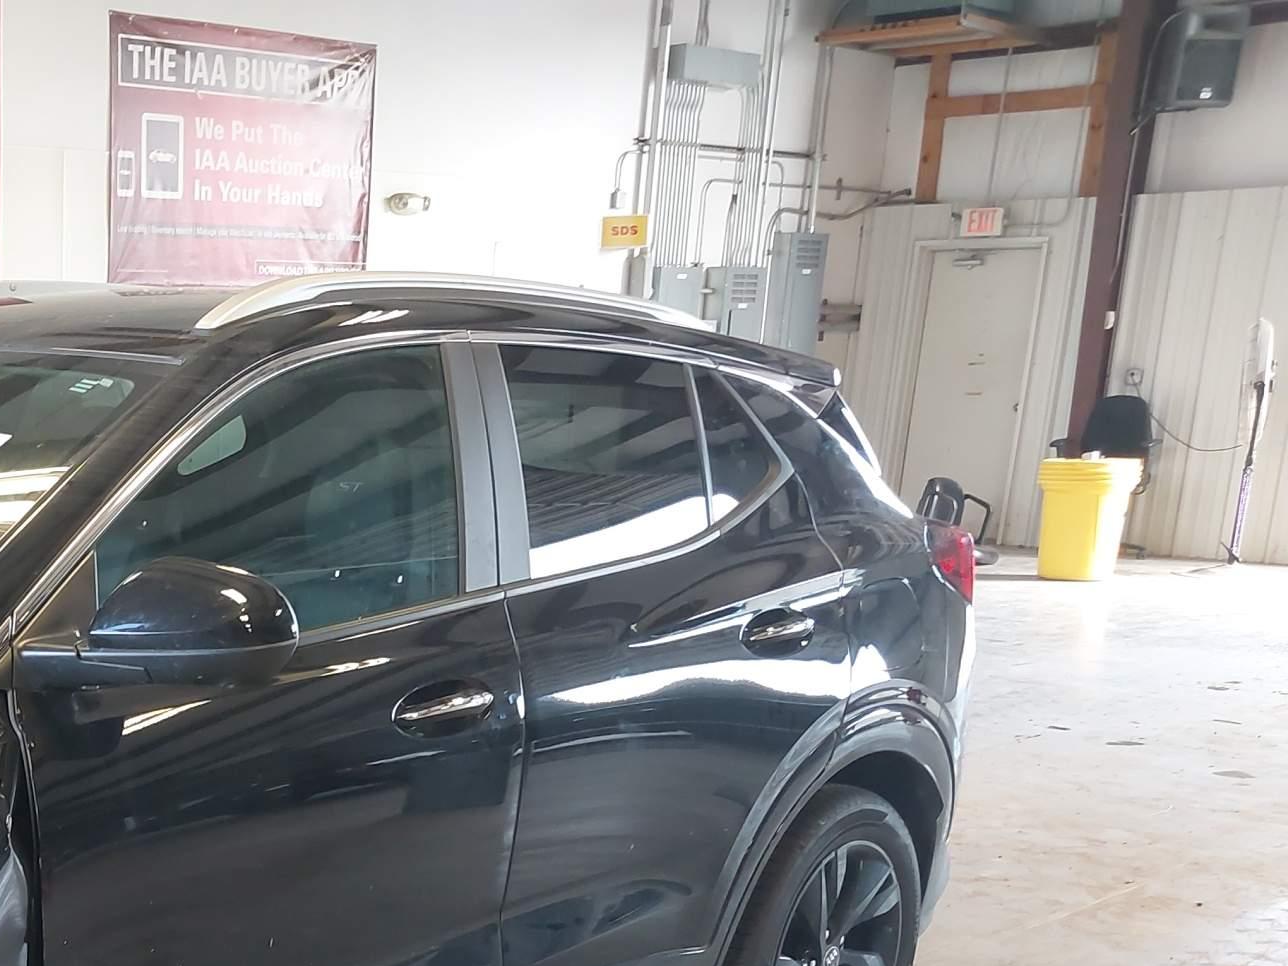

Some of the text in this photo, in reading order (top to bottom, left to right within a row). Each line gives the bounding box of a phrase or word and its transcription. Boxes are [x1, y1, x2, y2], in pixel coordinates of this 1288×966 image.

[127, 43, 177, 83] THE
[184, 50, 228, 88] IAA
[234, 56, 311, 96] BUYER
[194, 116, 305, 145] We Put The
[194, 148, 230, 172] IAA
[234, 150, 304, 177] Auction
[194, 178, 324, 208] In Your Hands
[611, 225, 639, 236] SDS
